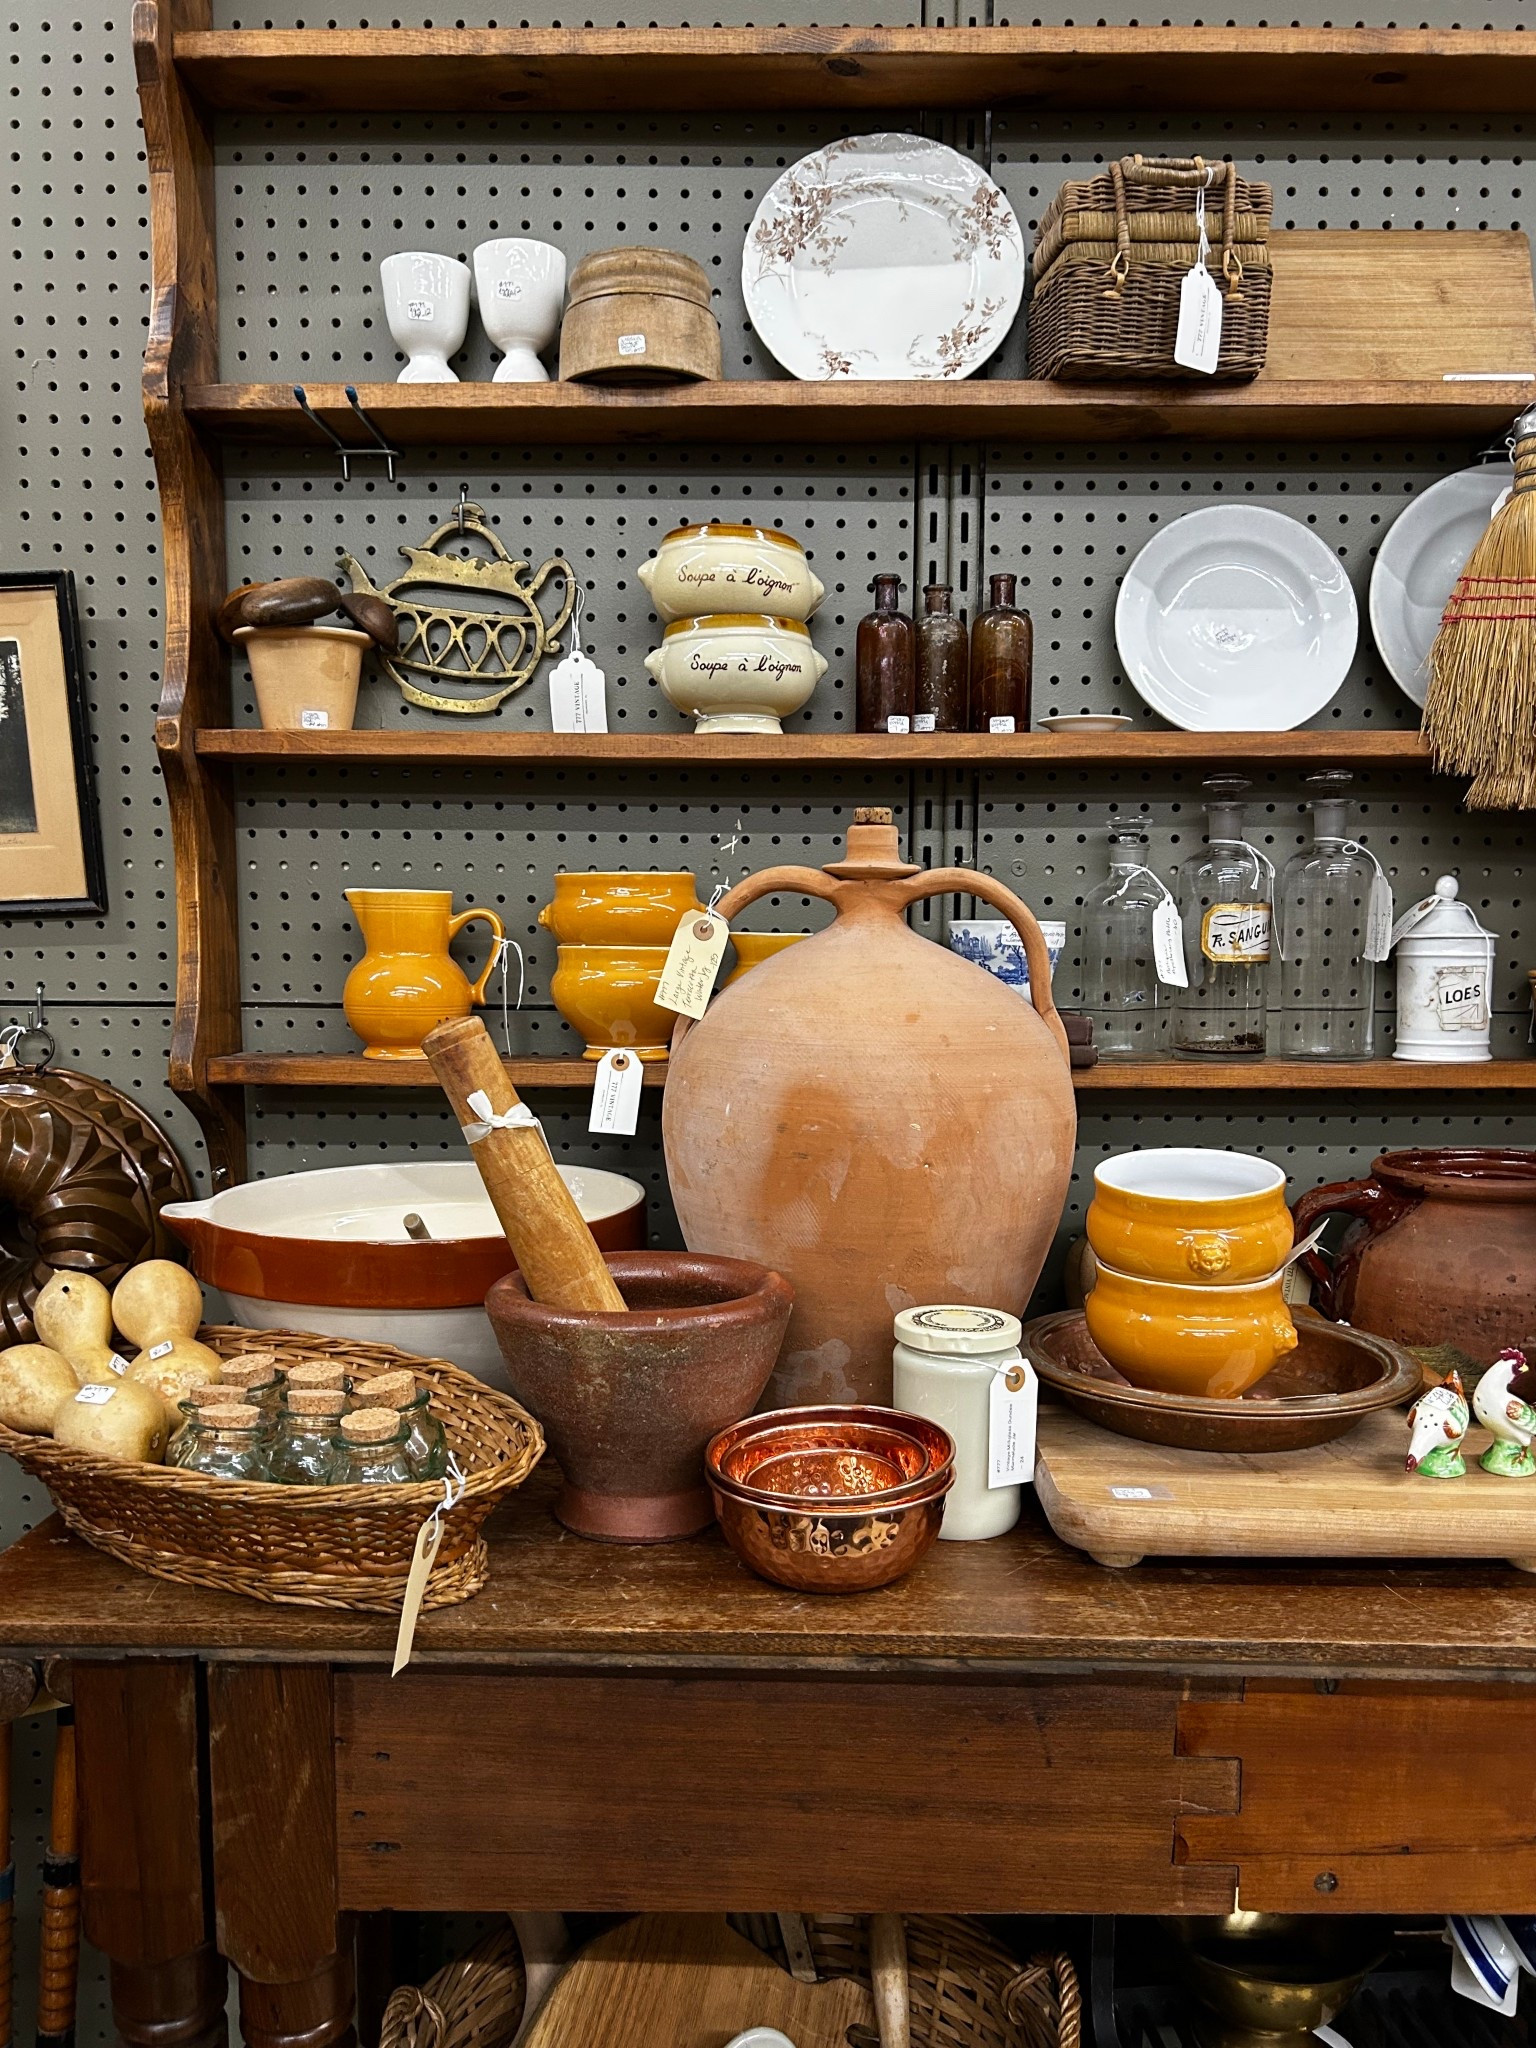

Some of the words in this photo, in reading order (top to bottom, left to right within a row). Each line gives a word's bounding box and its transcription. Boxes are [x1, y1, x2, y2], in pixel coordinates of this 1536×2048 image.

[678, 564, 716, 587] Soupe
[726, 569, 737, 583] à
[690, 653, 729, 680] Soupe
[738, 657, 748, 671] à
[573, 681, 581, 711] VINTAGE
[676, 945, 695, 979] Vintage
[668, 980, 686, 1006] Large
[610, 1081, 619, 1093] 777
[605, 1094, 616, 1122] VINTAGE
